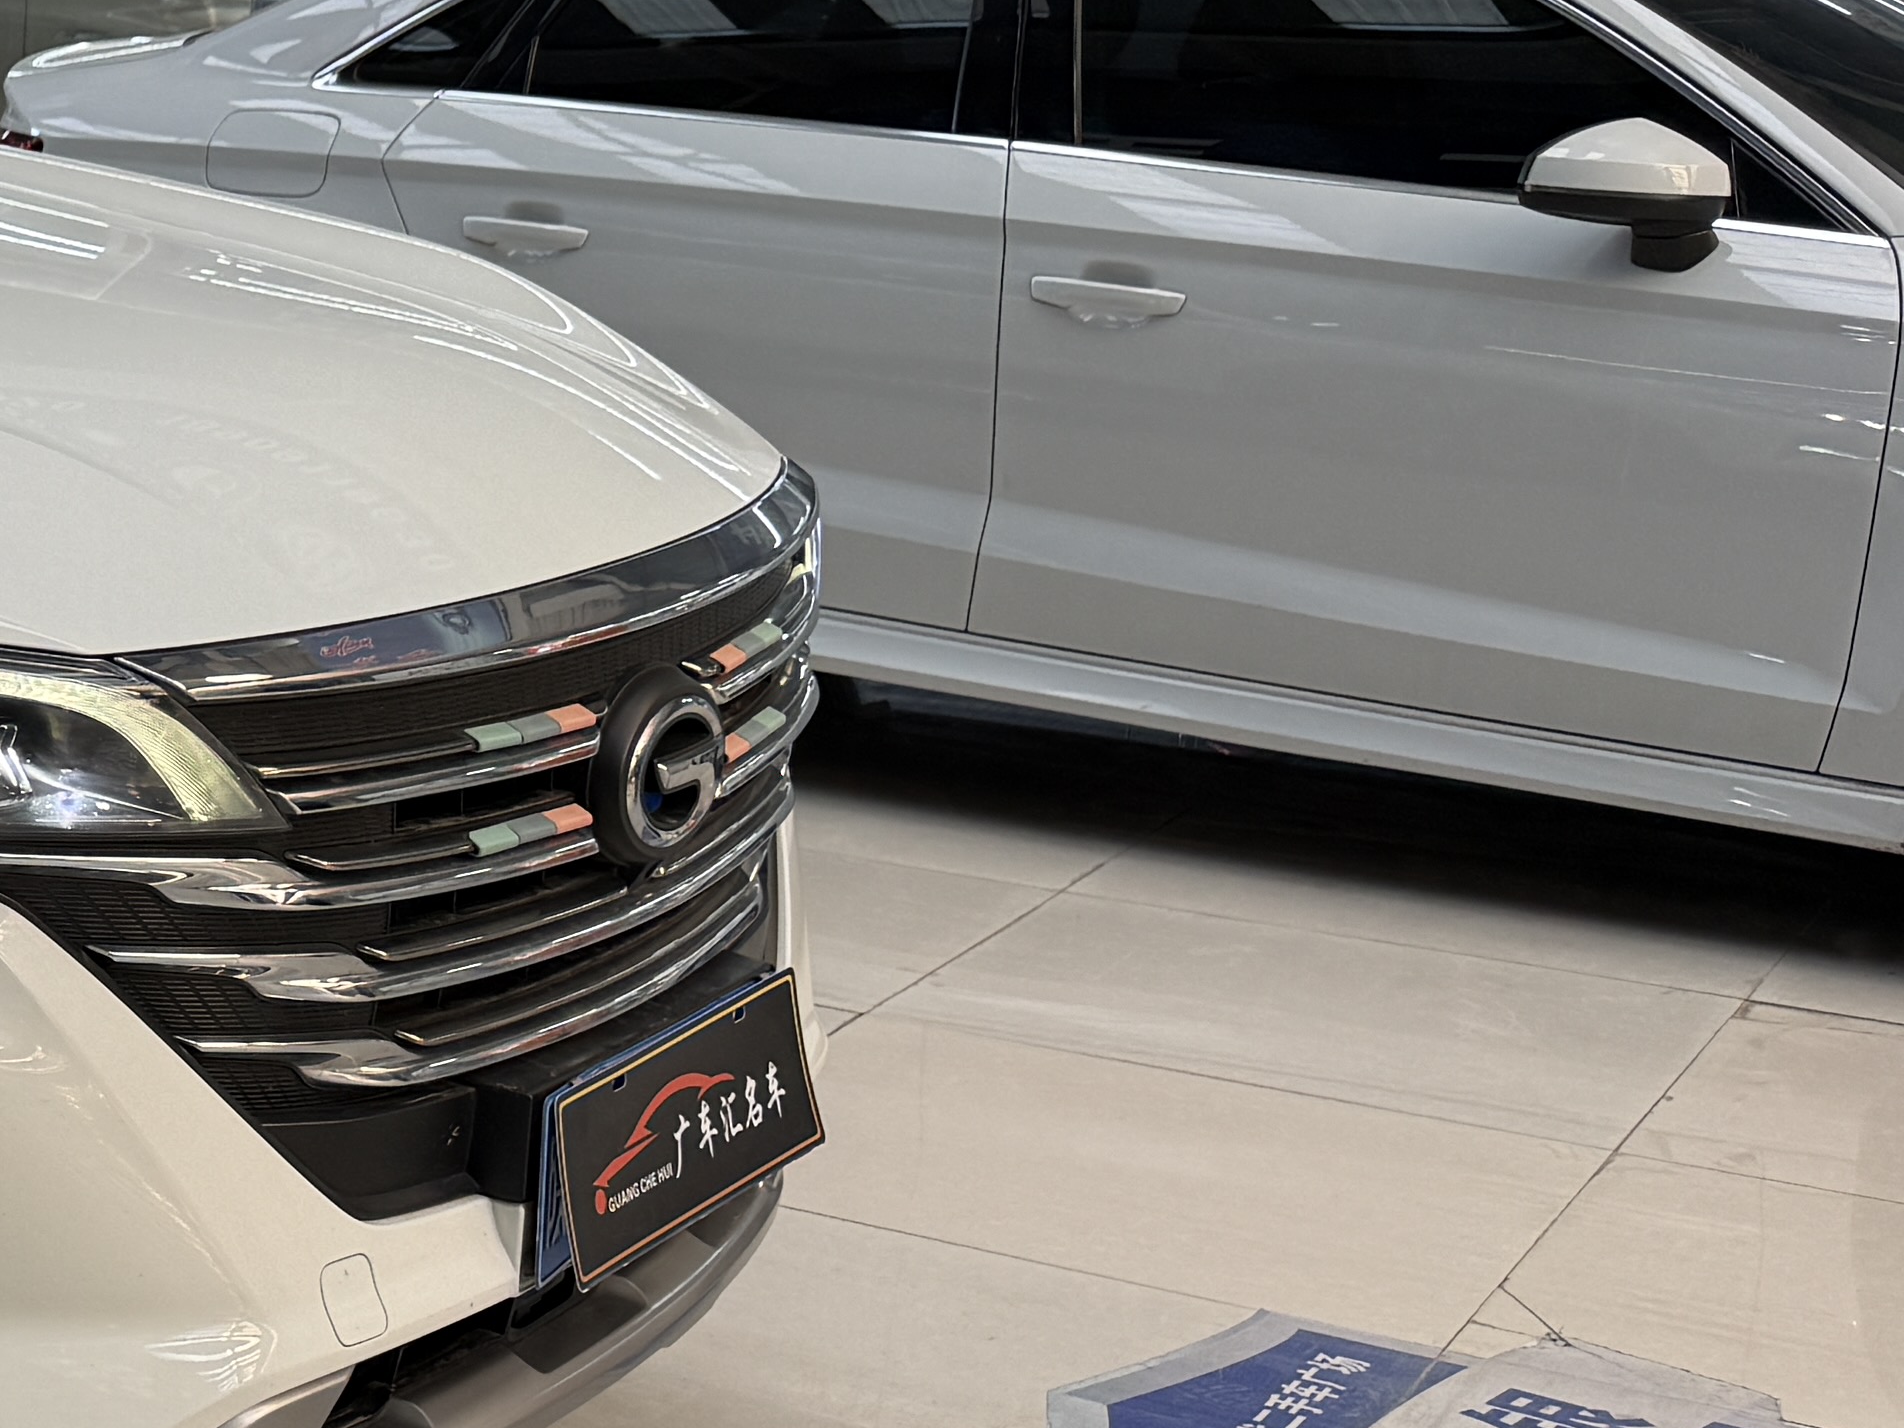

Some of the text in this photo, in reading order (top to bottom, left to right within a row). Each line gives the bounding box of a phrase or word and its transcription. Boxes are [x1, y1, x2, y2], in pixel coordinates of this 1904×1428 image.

[672, 1061, 786, 1179] 广车汇名车
[607, 1161, 674, 1214] GUANG CHE HUI
